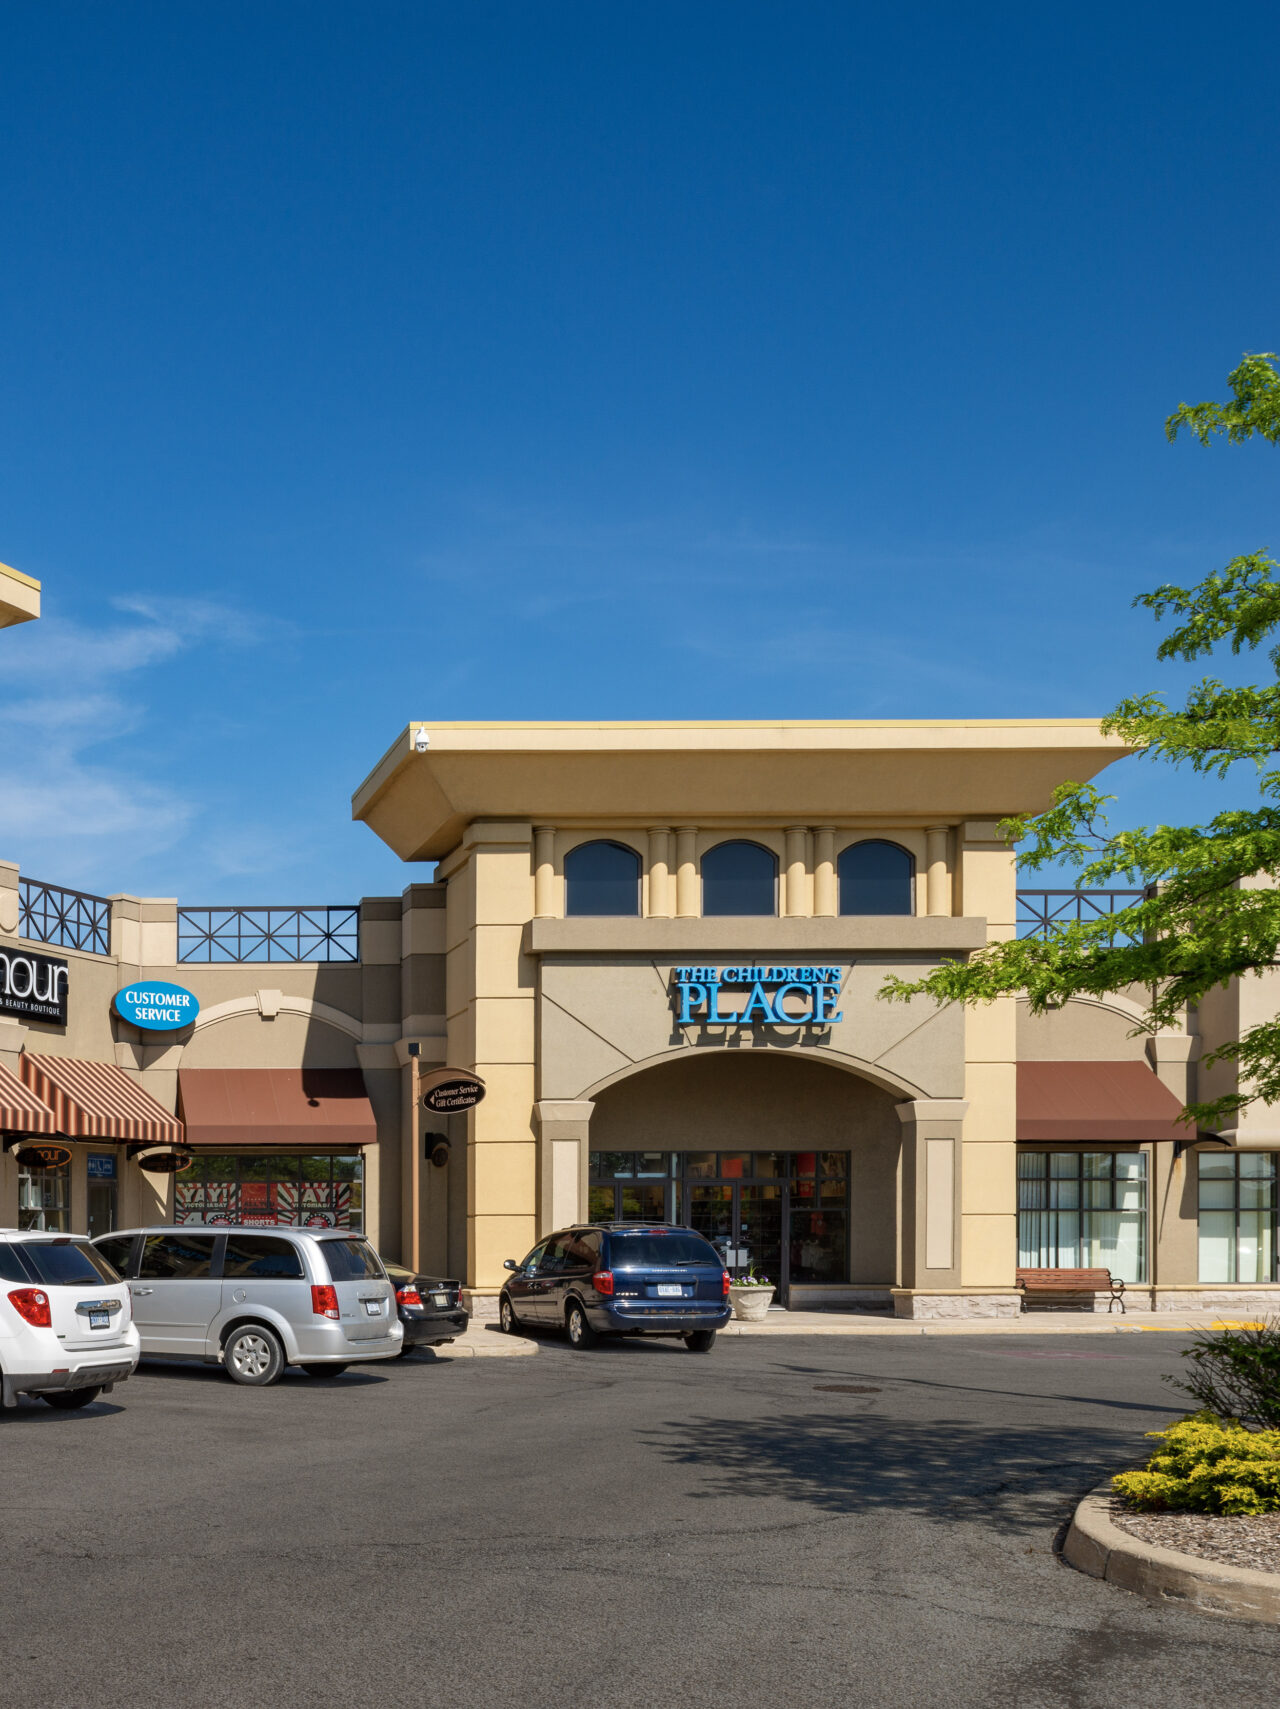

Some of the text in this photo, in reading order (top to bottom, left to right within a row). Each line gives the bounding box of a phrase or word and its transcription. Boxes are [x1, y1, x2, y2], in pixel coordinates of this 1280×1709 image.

[676, 967, 843, 982] THE CHILDREN'S
[125, 991, 190, 1007] CUSTOMER
[676, 982, 843, 1023] PLACE
[5, 999, 28, 1009] BEAUTY
[30, 1003, 60, 1015] BOUTIQUE
[135, 1007, 181, 1022] SERVICE
[435, 1085, 479, 1098] Customer Service
[435, 1096, 476, 1108] Gift Certificates
[181, 1188, 228, 1202] YAY!
